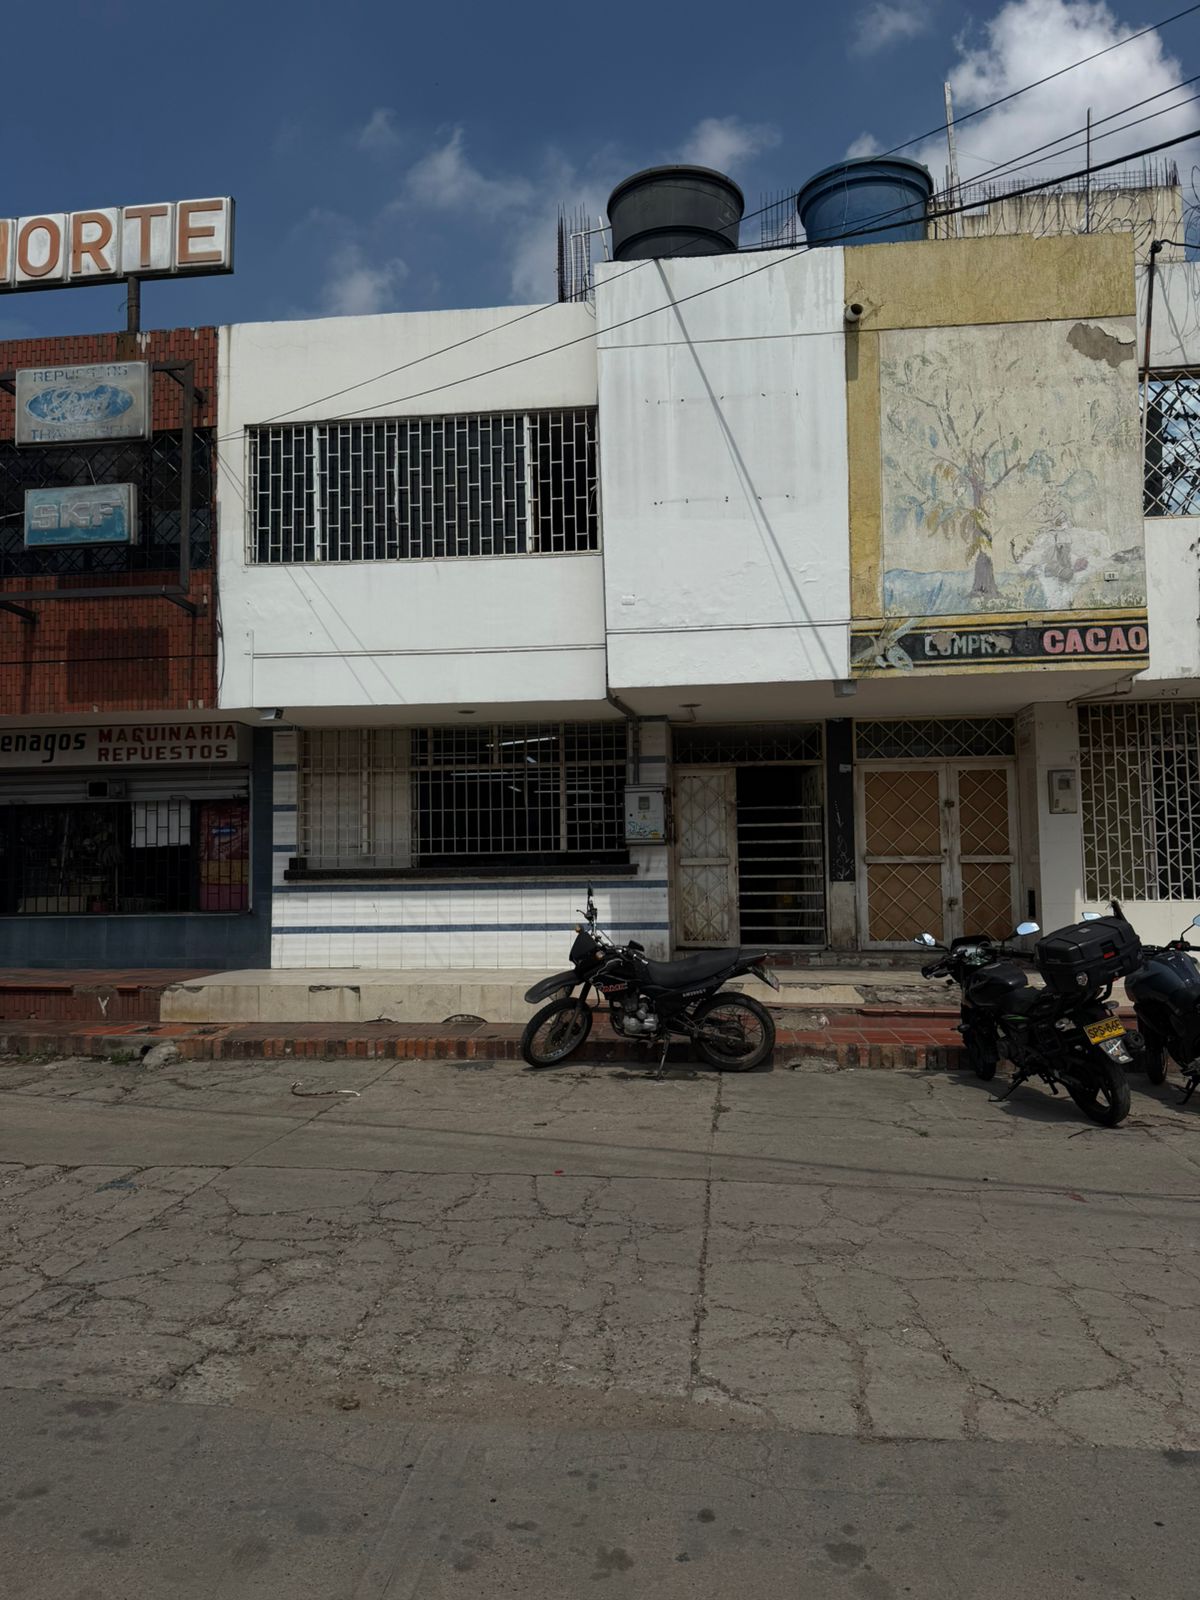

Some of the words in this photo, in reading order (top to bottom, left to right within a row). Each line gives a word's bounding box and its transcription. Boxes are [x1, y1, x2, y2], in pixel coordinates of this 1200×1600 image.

[31, 500, 121, 530] SKF
[1043, 626, 1148, 653] CACAO
[0, 732, 86, 763] enagos
[98, 725, 236, 745] MAQUINARIA
[98, 744, 228, 762] REPUESTOS
